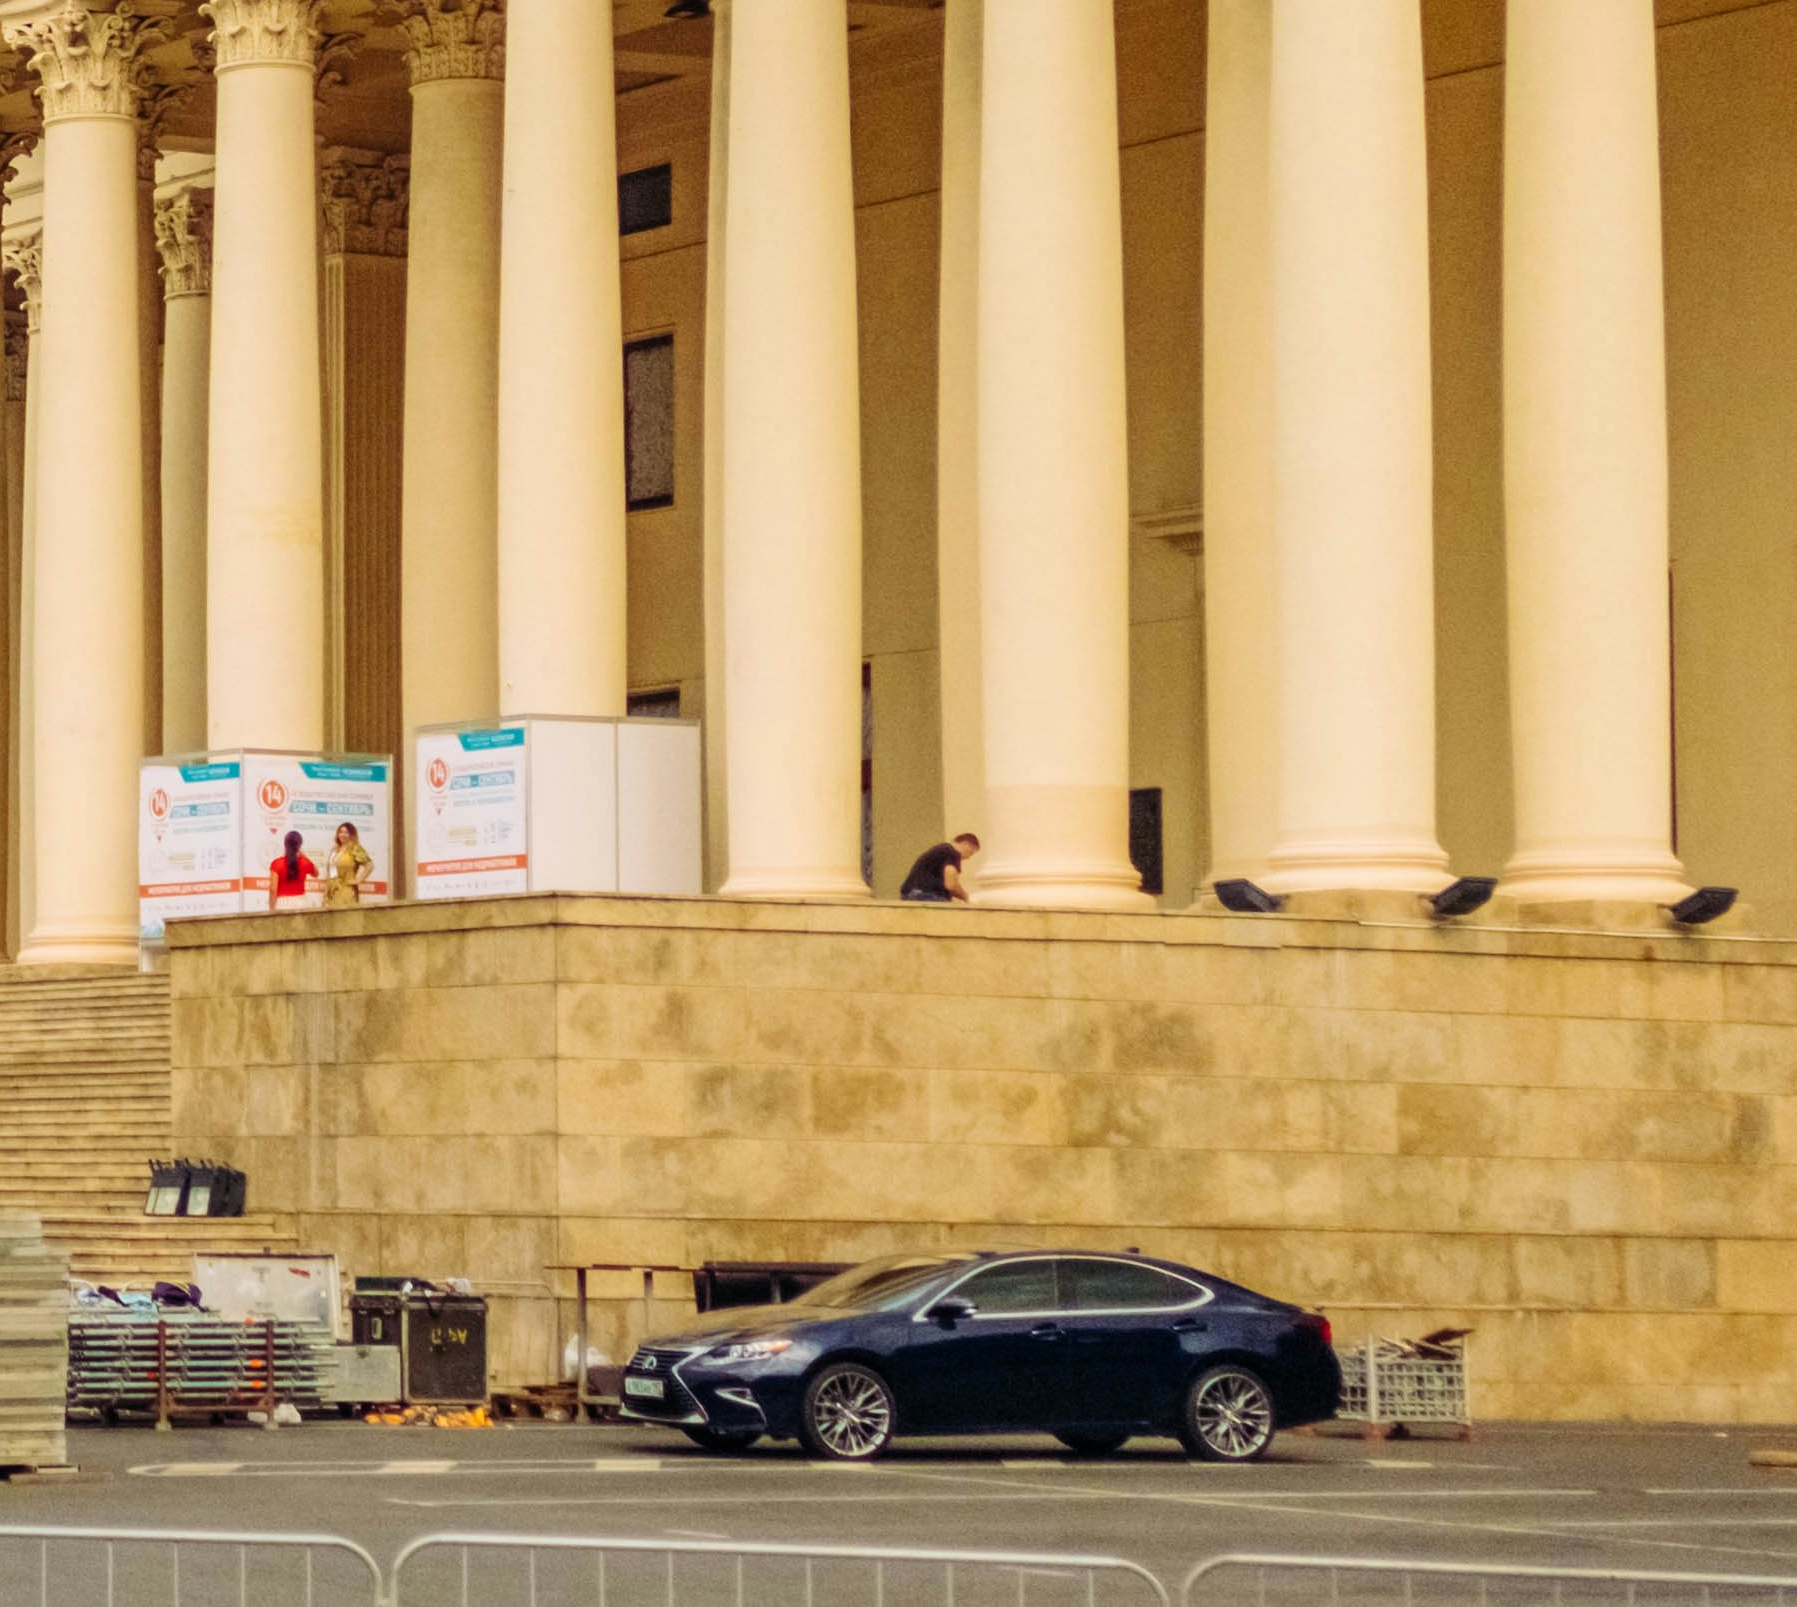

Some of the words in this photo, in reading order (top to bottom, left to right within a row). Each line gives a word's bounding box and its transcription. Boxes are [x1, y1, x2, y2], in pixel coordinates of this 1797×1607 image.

[433, 759, 445, 784] 14
[152, 791, 167, 816] 14
[265, 784, 282, 804] 14
